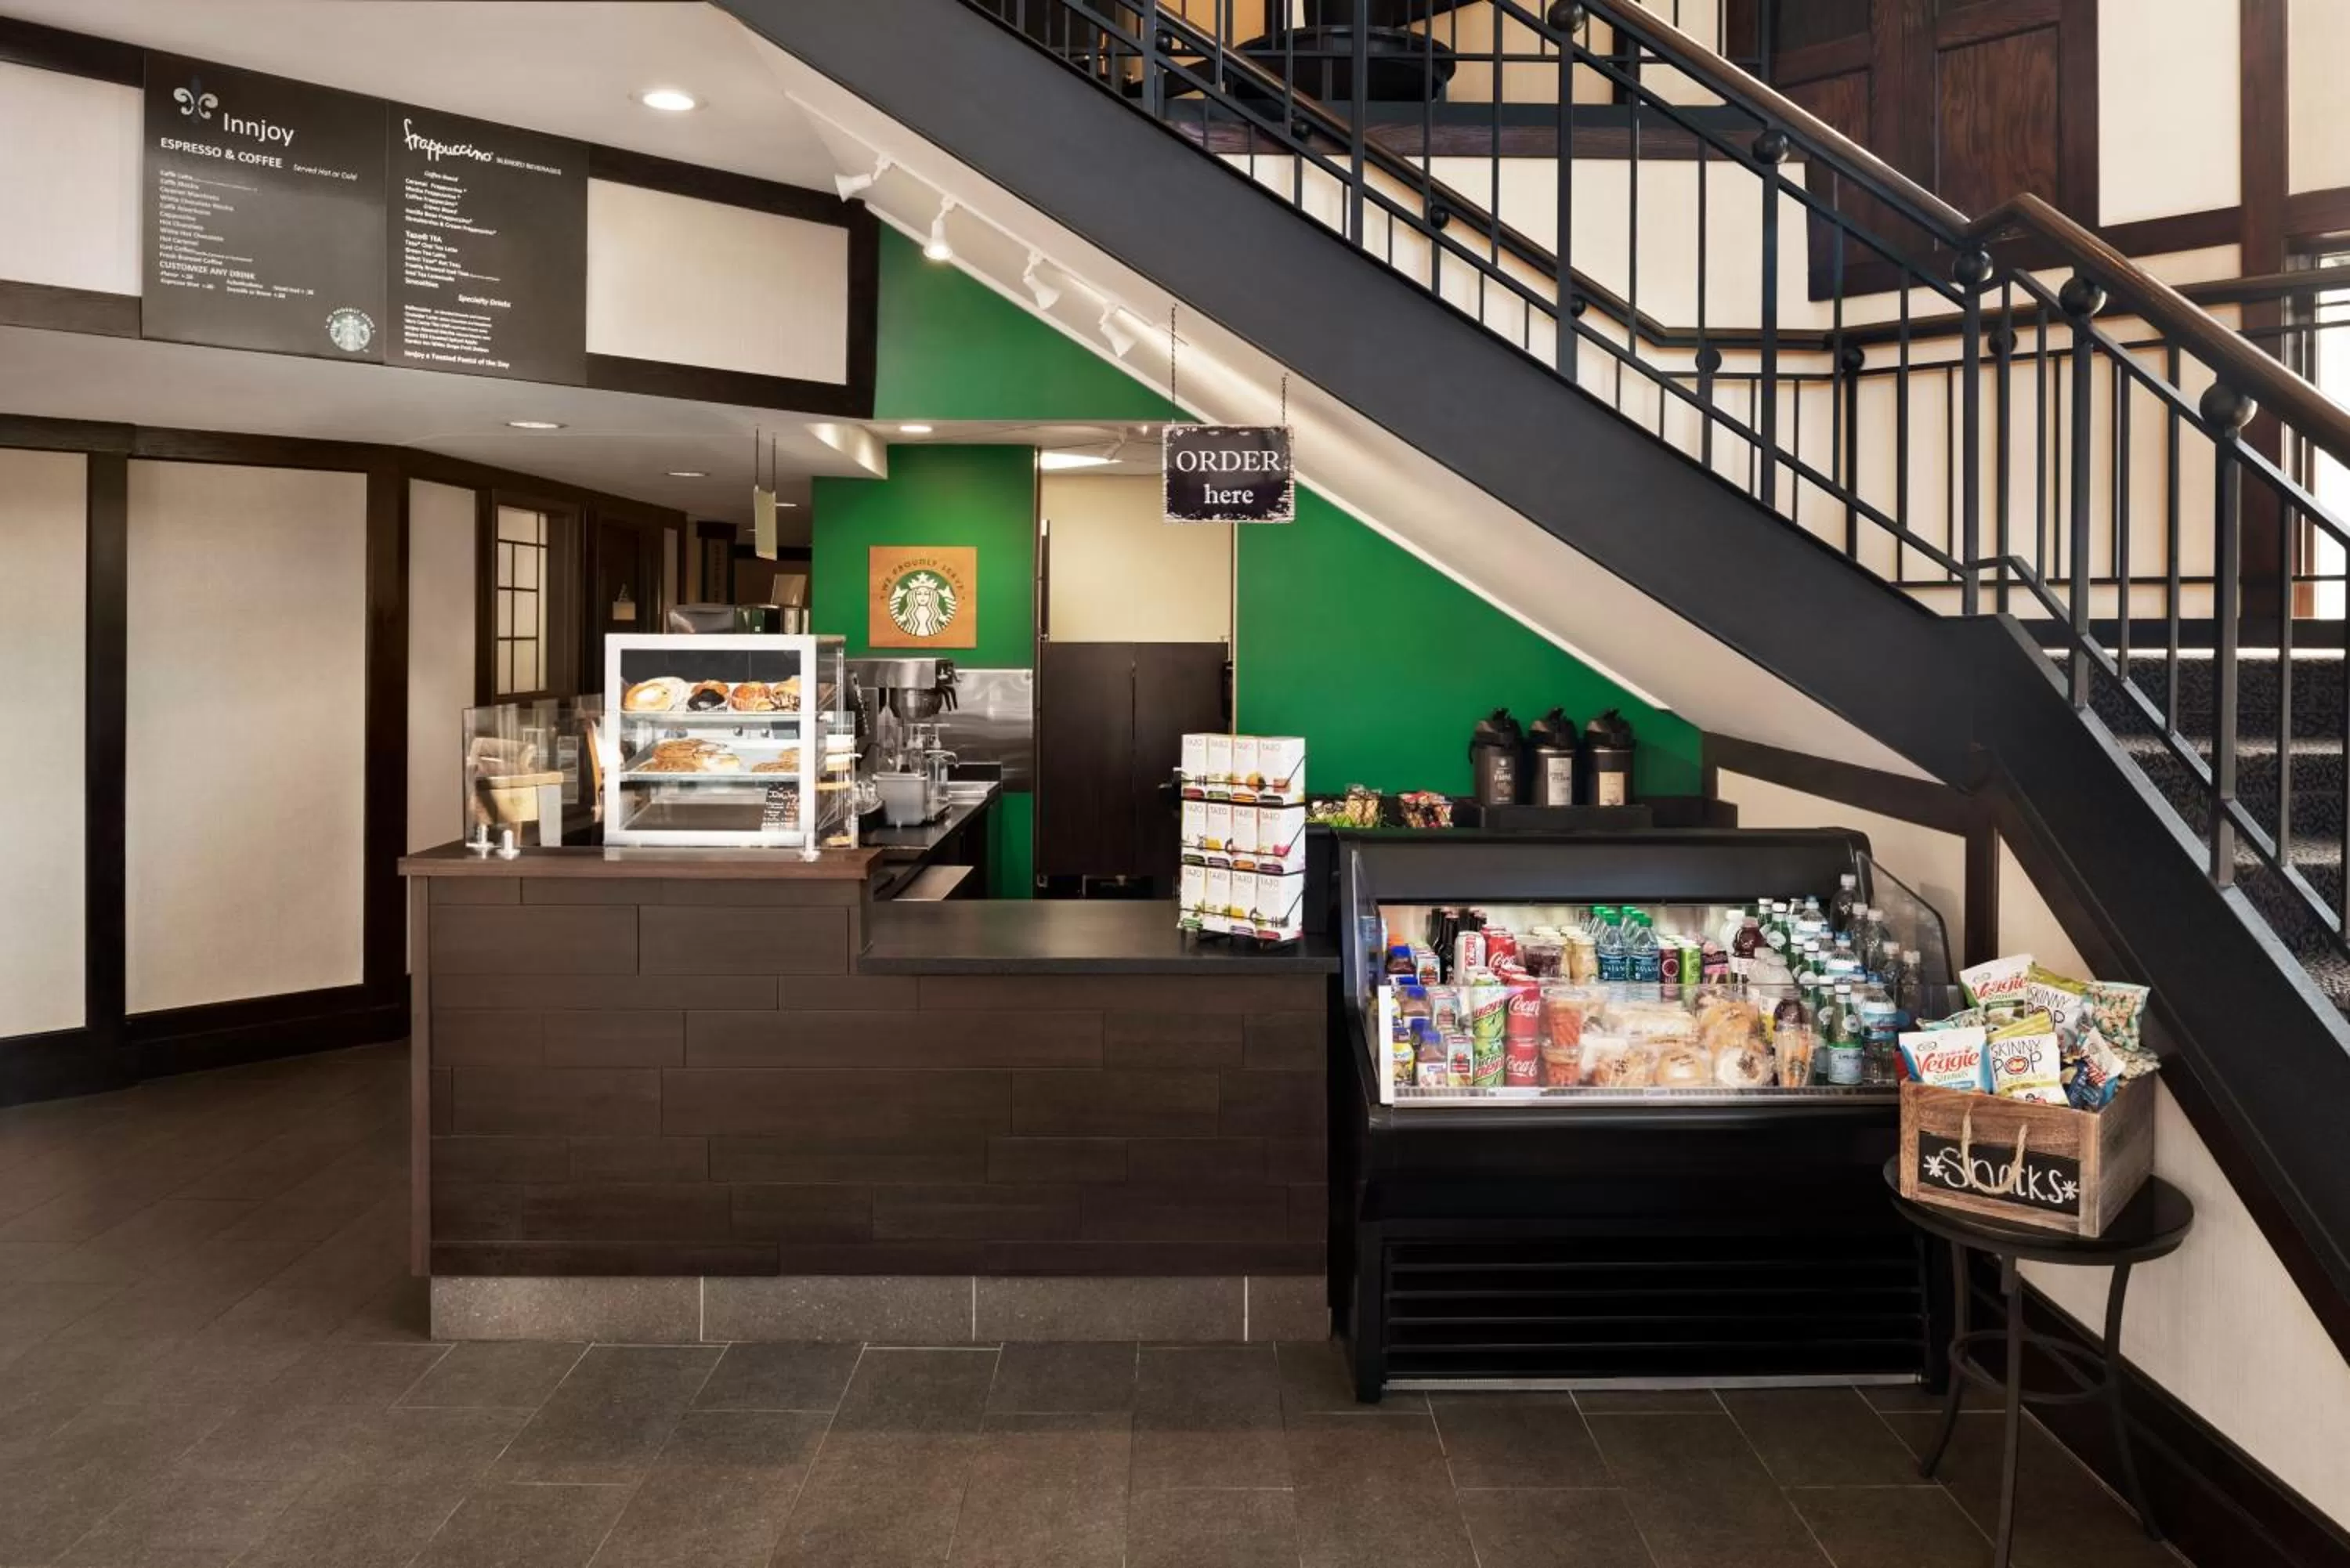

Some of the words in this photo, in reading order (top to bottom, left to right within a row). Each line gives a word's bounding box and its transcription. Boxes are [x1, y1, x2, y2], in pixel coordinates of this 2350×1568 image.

[223, 113, 294, 146] Innjoy
[161, 137, 222, 157] ESPRESSO
[225, 149, 234, 160] &
[238, 151, 283, 168] COFFEE
[159, 259, 208, 273] CUSTOMIZE
[210, 266, 227, 276] ANY
[230, 269, 255, 280] DRINK
[1176, 450, 1281, 471] ORDER
[1203, 483, 1254, 504] here
[2030, 987, 2070, 1008] SKINNY
[1990, 1040, 2040, 1059] SKINNY
[1915, 1050, 1979, 1076] Veggie
[1993, 1050, 2042, 1081] POP
